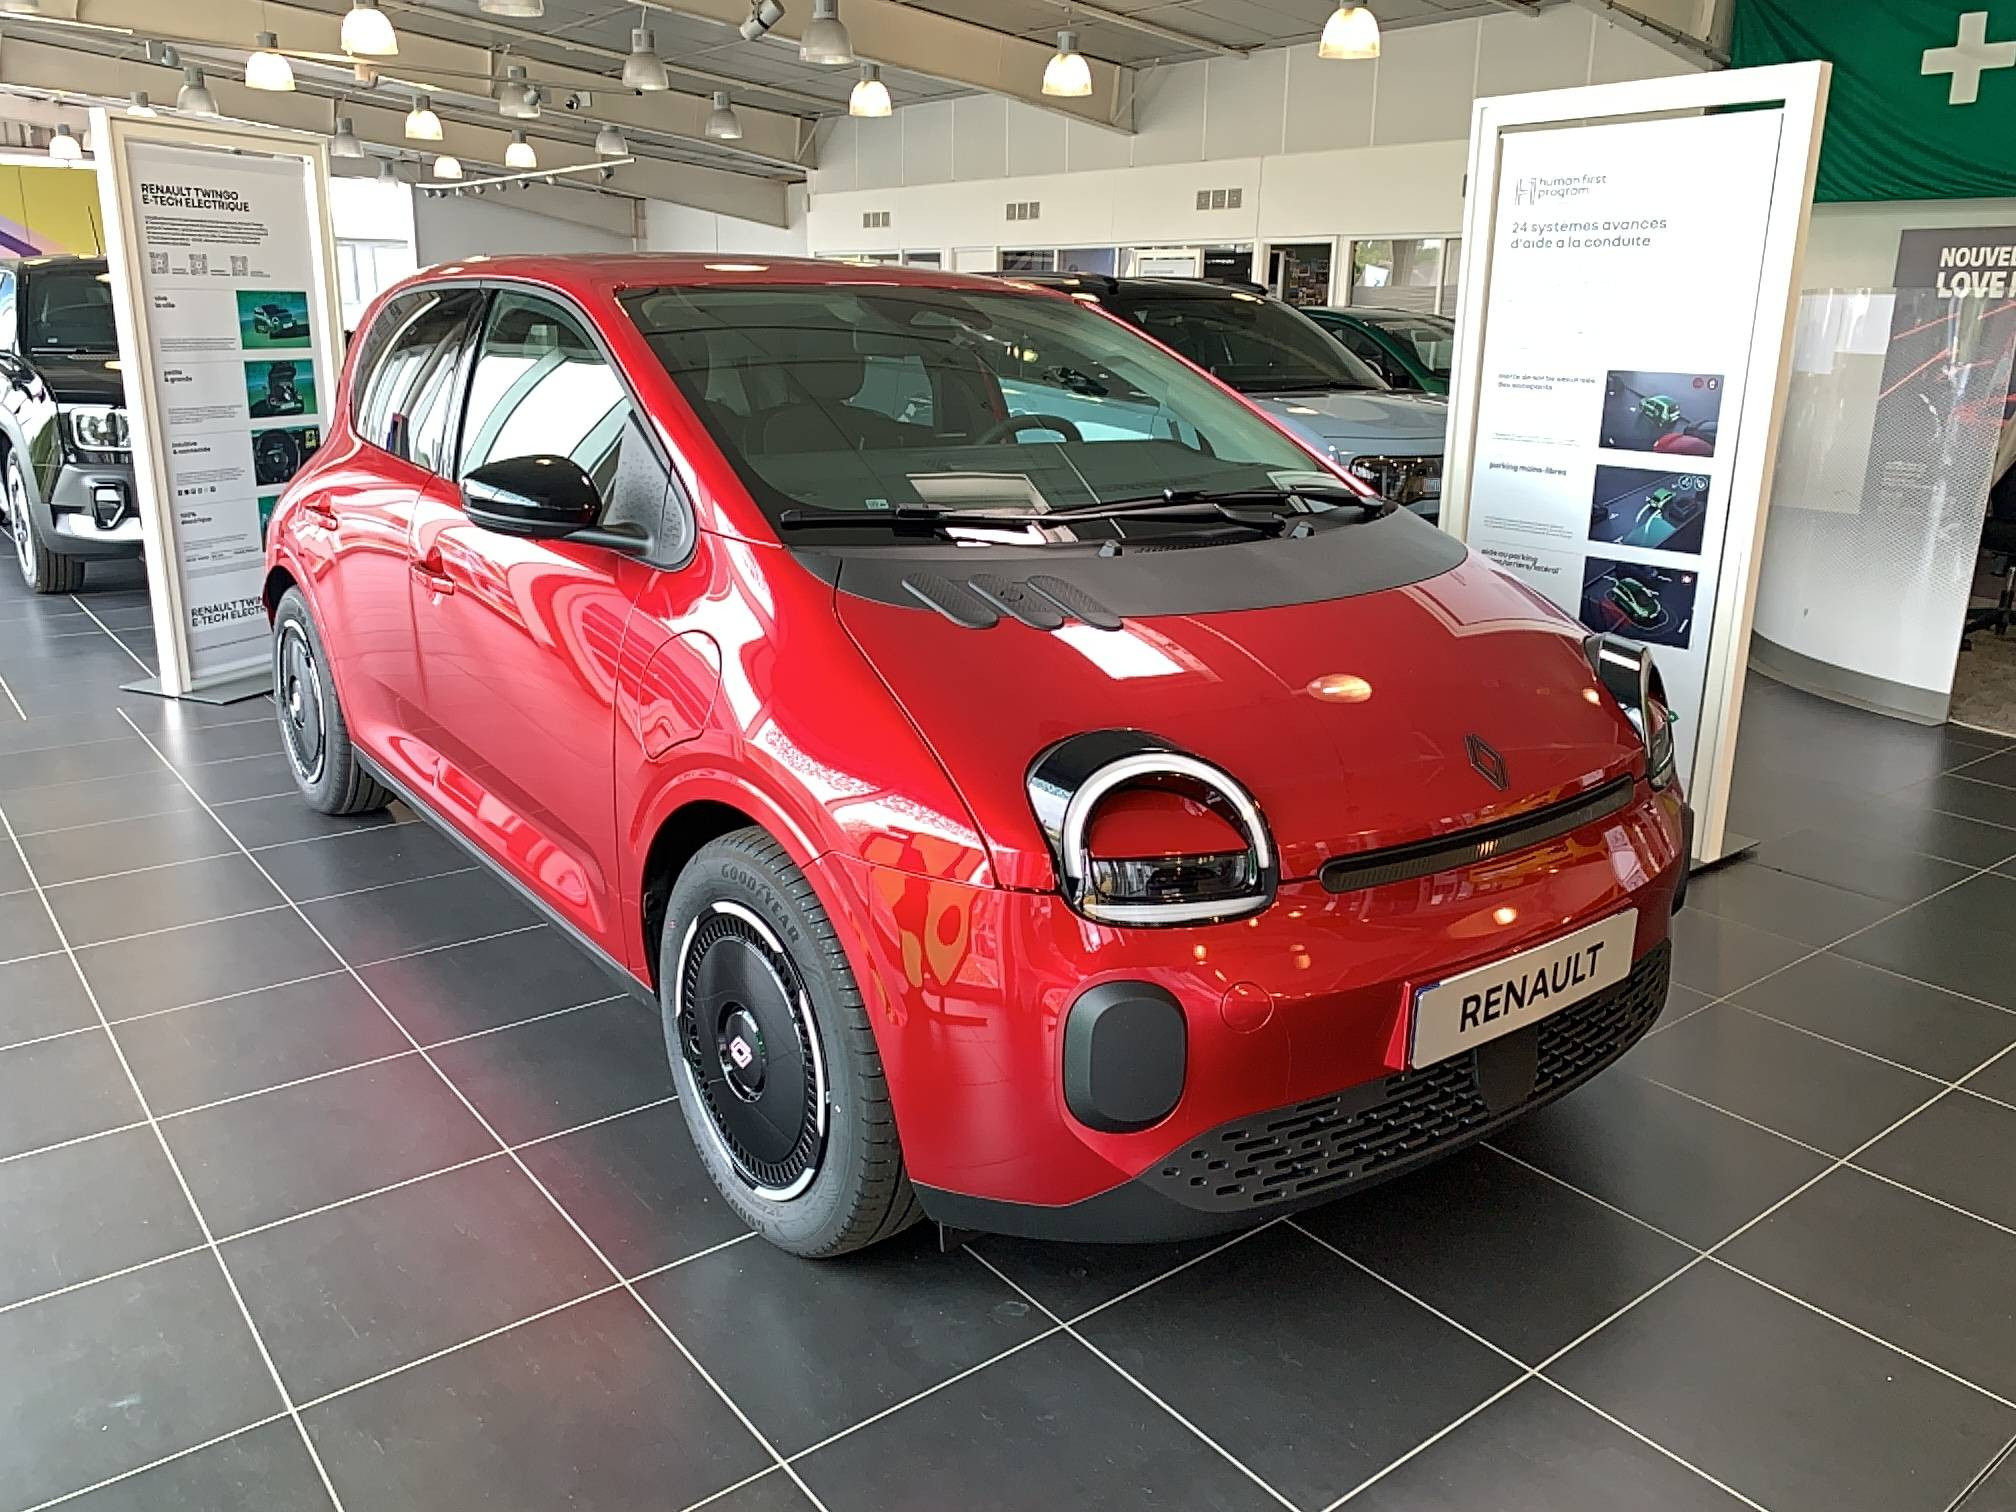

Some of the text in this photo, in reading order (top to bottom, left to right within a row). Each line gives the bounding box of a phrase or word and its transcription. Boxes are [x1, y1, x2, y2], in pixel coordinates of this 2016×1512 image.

[141, 183, 239, 201] RENAULT TWINGO
[143, 194, 250, 212] E-TECH ELECTRIQUE
[1512, 221, 1528, 234] 24
[1568, 236, 1581, 248] la
[1584, 235, 1651, 248] conduite
[1936, 271, 2008, 299] LOVE
[191, 601, 236, 617] RENAULT
[192, 611, 229, 627] E-TECH
[721, 862, 799, 943] GOODYEAR
[1460, 941, 1604, 1033] RENAULT
